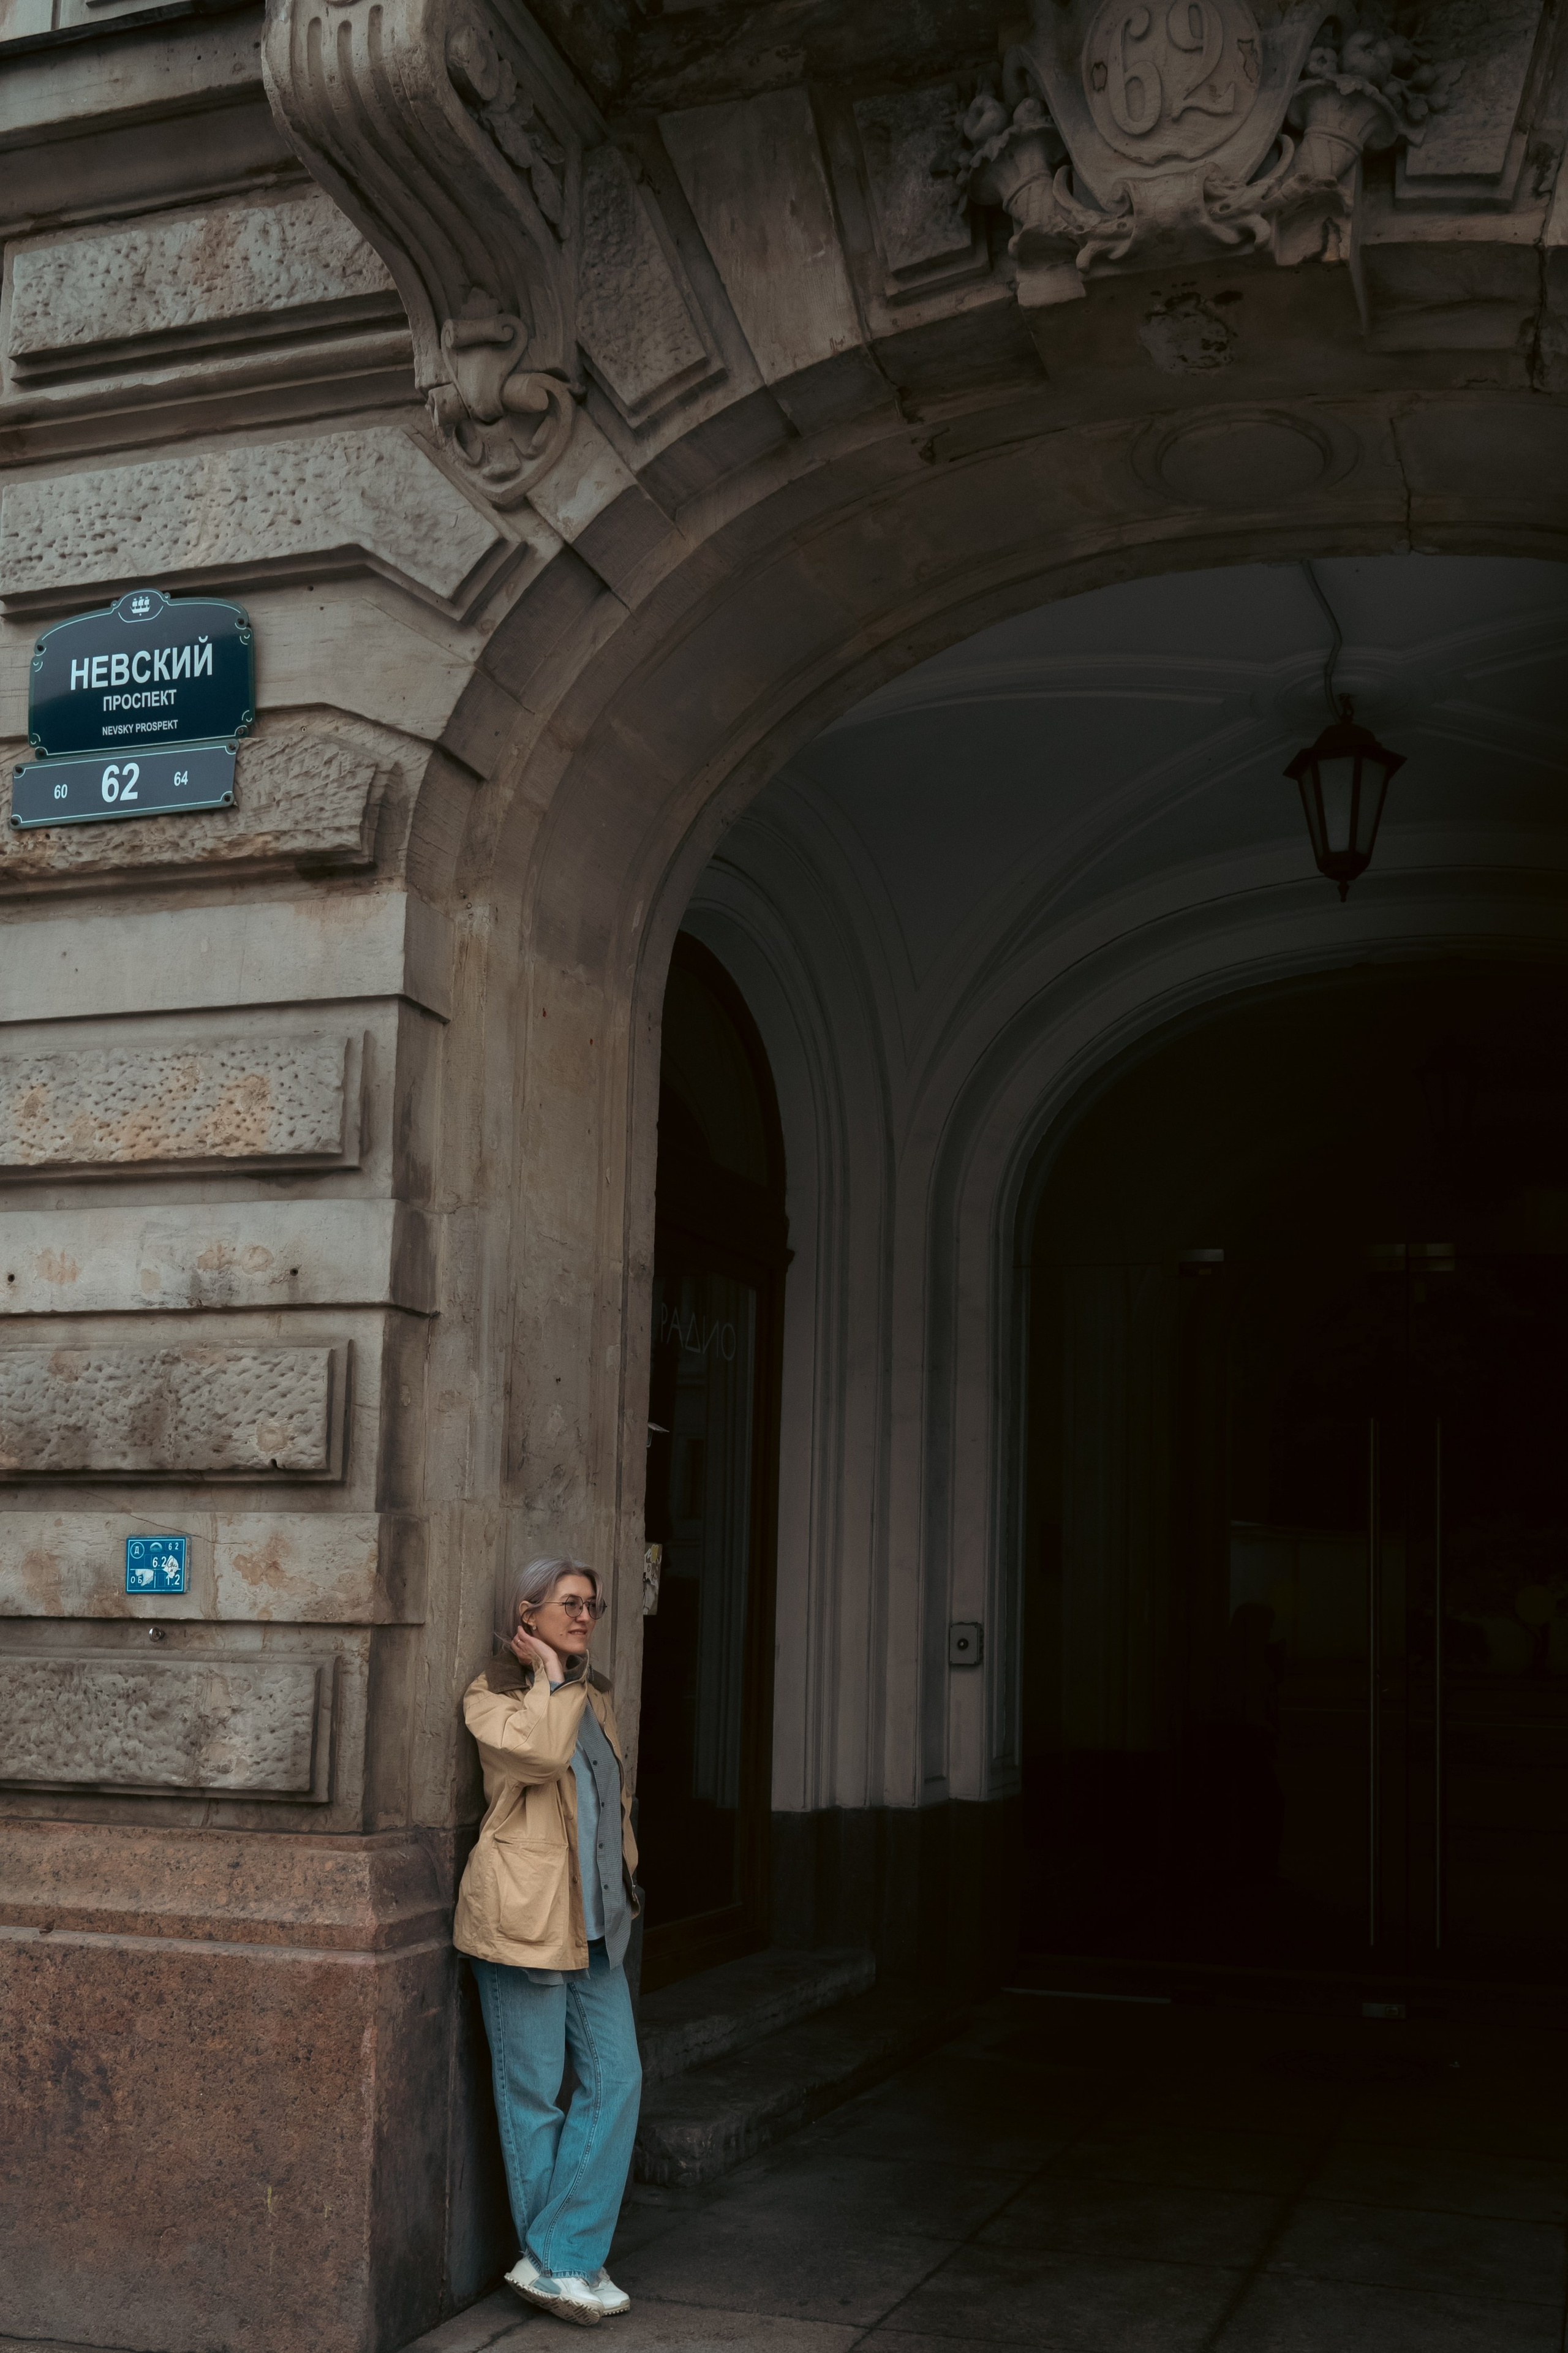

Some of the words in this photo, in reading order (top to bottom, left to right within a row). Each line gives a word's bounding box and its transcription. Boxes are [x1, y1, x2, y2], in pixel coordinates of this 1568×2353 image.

[1108, 0, 1236, 137] 62
[70, 635, 213, 691] НЕВСКИЙ
[103, 689, 177, 712] ПРОСПЕКТ
[102, 723, 134, 736] NEVSKY
[135, 719, 178, 733] PROSPEKT
[54, 784, 68, 799] 60
[101, 762, 140, 803] 62
[173, 770, 189, 787] 64
[134, 1546, 140, 1555] Д
